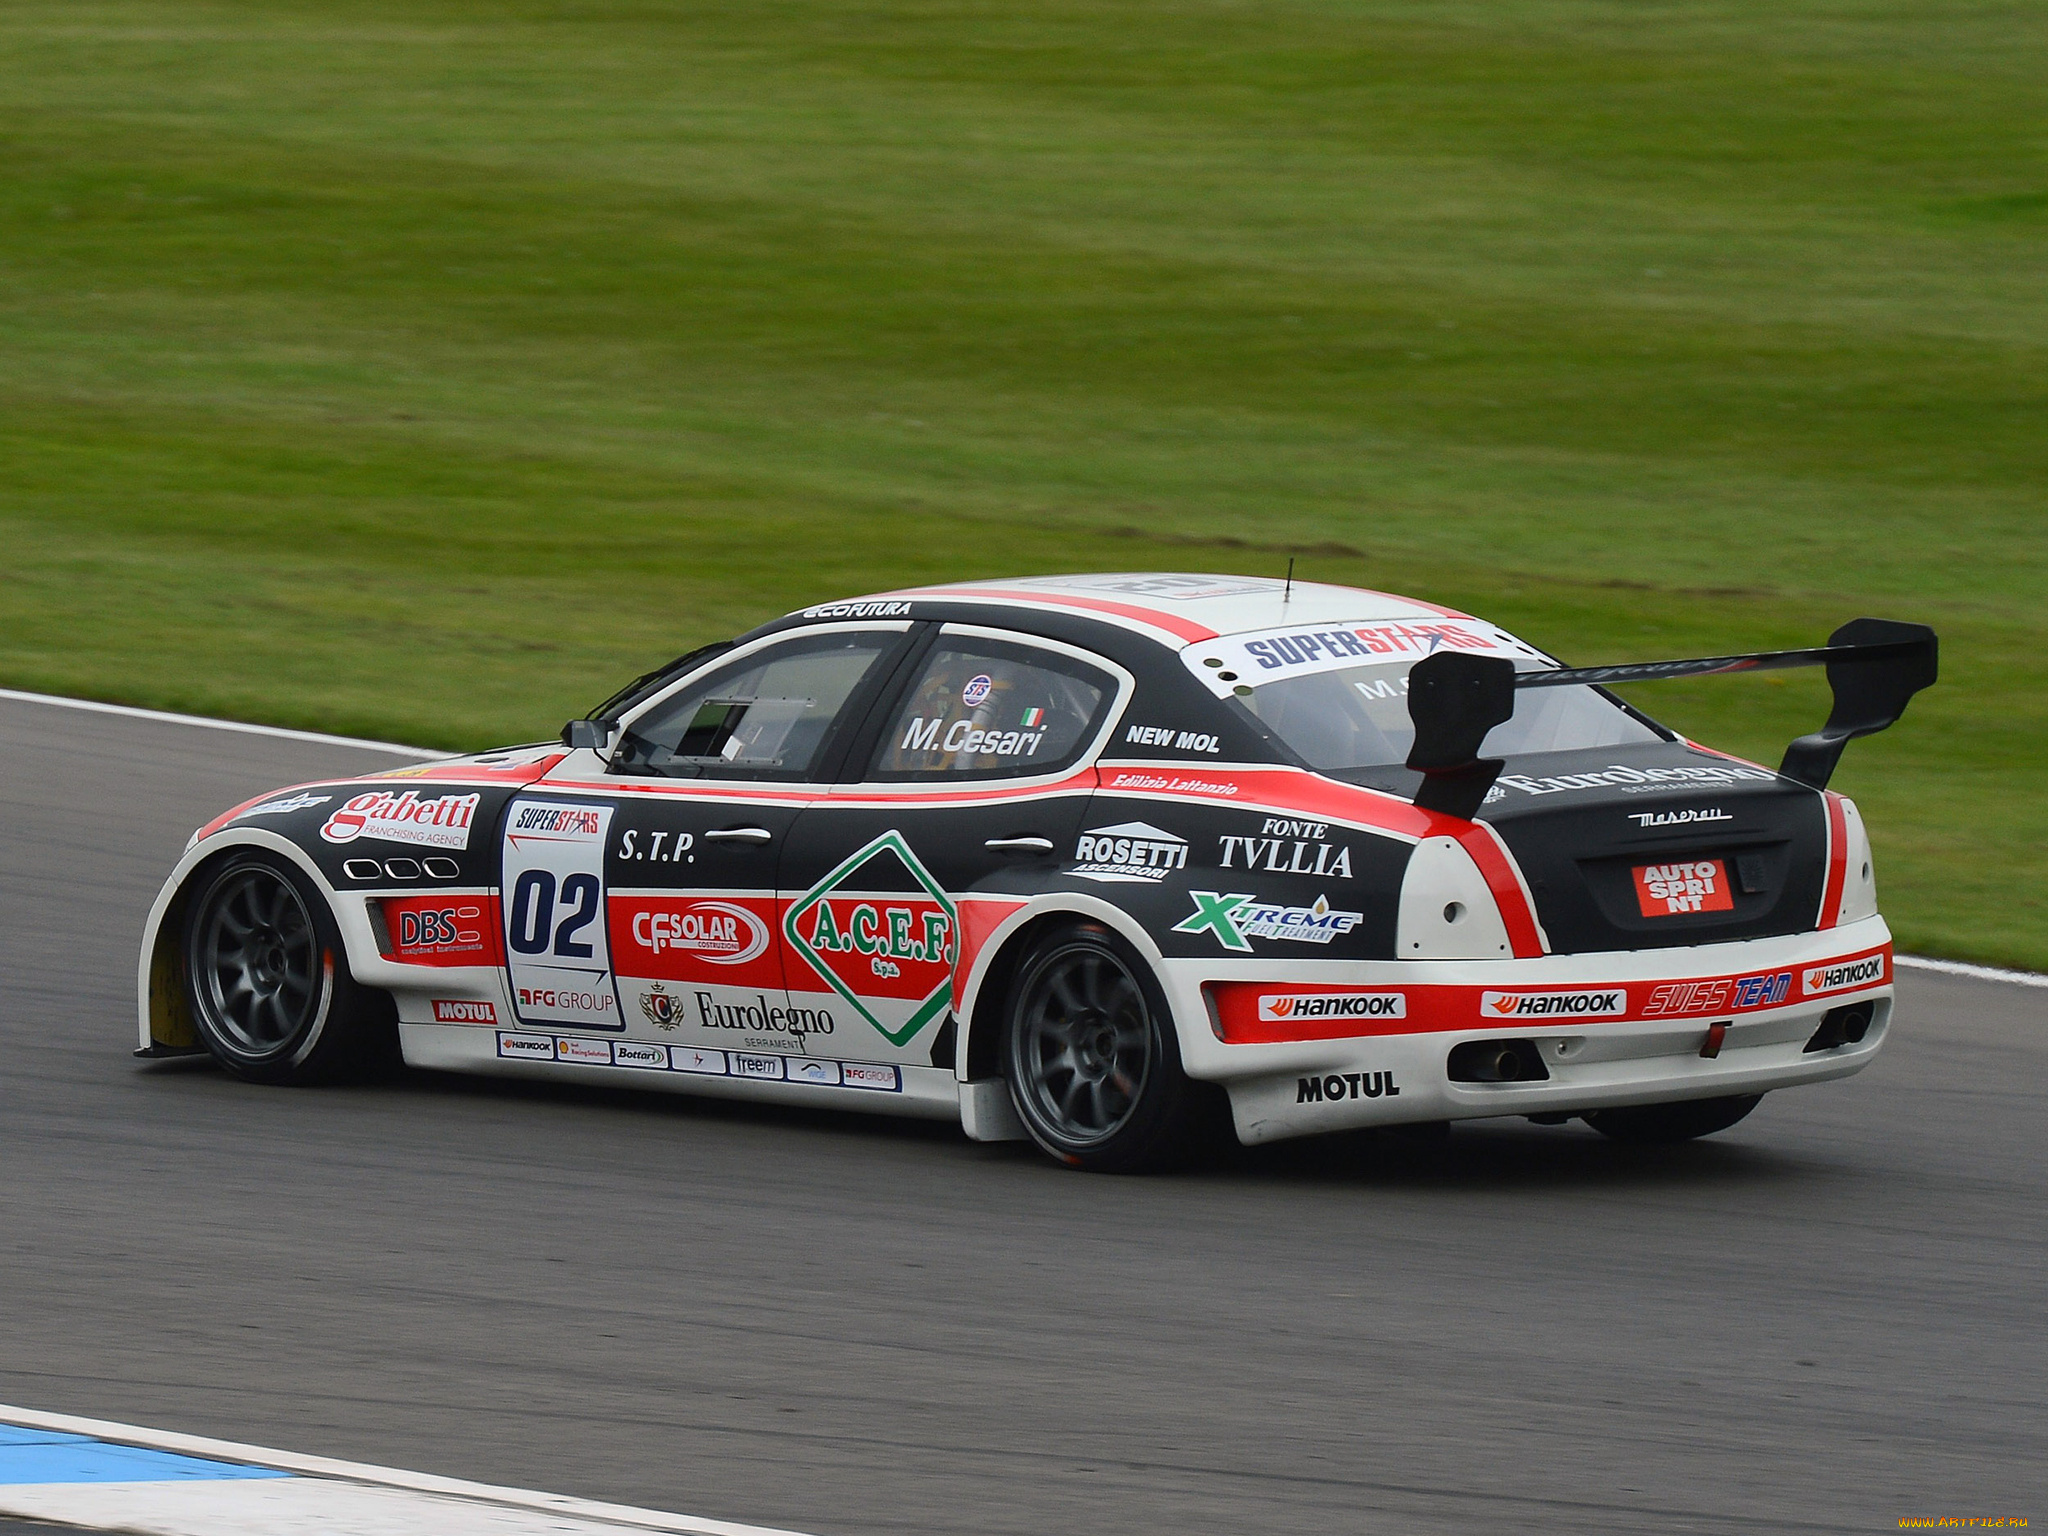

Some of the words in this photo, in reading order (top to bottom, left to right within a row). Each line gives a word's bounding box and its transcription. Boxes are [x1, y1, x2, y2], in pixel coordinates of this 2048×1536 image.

[901, 717, 1048, 756] M.Cesari
[1126, 725, 1175, 746] NEW
[1175, 731, 1220, 753] MOL
[1110, 774, 1168, 789] Edilizia
[1166, 777, 1238, 795] Lattanzio
[1497, 765, 1776, 796] Eurolegno
[324, 792, 468, 838] gabetti
[516, 808, 599, 835] SUPERSTARS
[364, 825, 424, 841] FRANCHISING
[426, 834, 465, 846] AGENCY
[1261, 818, 1328, 840] FONTE
[1075, 836, 1189, 869] ROSETTI
[1218, 835, 1353, 879] TVLLIA
[1072, 863, 1170, 879] ASCENSORI
[1643, 862, 1716, 883] AUTO
[1649, 878, 1715, 899] SPRI
[510, 869, 600, 958] 02
[1667, 895, 1703, 913] NT
[400, 908, 457, 946] DBS
[670, 913, 738, 940] SOLAR
[1243, 923, 1273, 934] FUEL
[1273, 925, 1333, 940] TREATMENT
[698, 941, 738, 950] COSTRUZIONI
[558, 992, 613, 1011] GROUP
[1642, 981, 1732, 1014] SWISS
[1732, 973, 1792, 1007] TEAM
[439, 1003, 494, 1020] MOTUL
[694, 991, 834, 1041] Eurolegno
[618, 1048, 656, 1060] Bottari
[865, 1070, 895, 1082] GROUP
[1296, 1071, 1400, 1103] MOTUL
